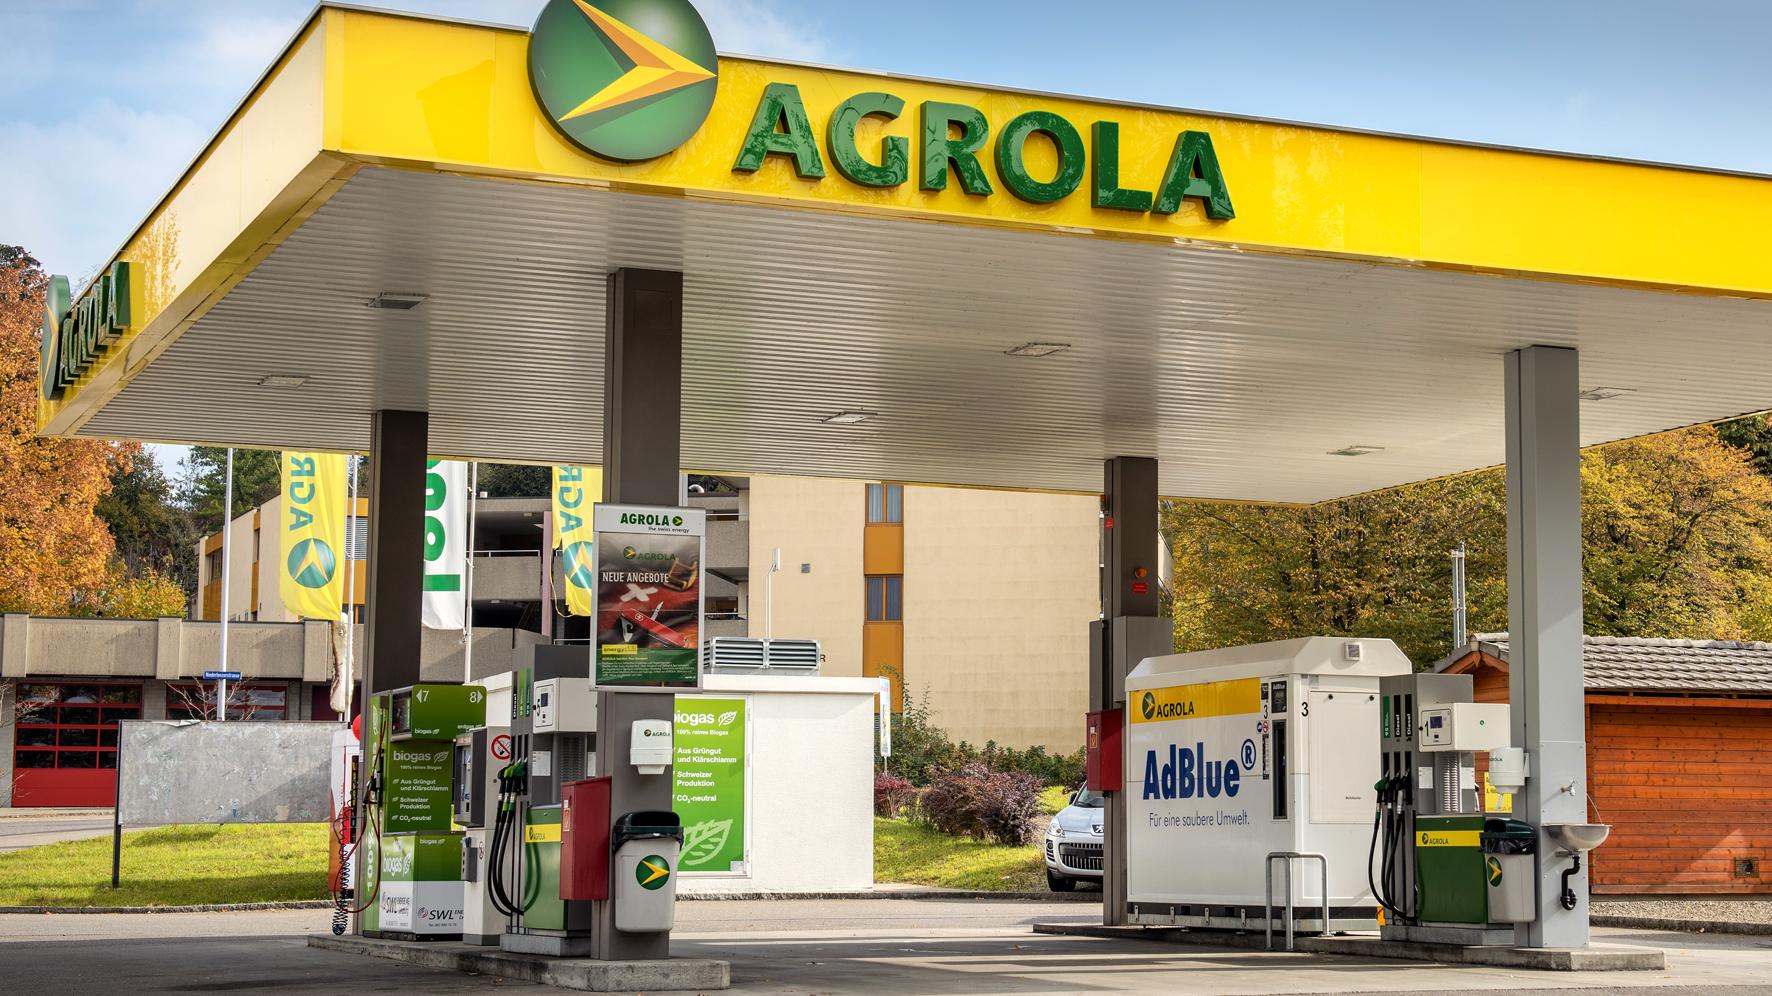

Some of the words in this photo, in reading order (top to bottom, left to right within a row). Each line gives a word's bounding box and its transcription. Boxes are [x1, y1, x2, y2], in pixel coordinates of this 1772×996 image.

[731, 82, 1236, 220] AGROLA
[620, 513, 670, 526] AGROLA
[637, 552, 676, 560] AGROLA
[602, 572, 624, 582] NEUE
[627, 572, 669, 583] ANGEBOTE
[423, 690, 429, 702] 7
[469, 691, 477, 703] 8
[536, 698, 541, 717] 5
[1156, 701, 1195, 718] AGROLA
[1263, 704, 1268, 719] 3
[1301, 701, 1309, 717] 3
[1424, 720, 1429, 737] 1
[393, 750, 431, 763] biogas
[692, 747, 721, 755] Grüngut
[677, 779, 715, 787] Produktion
[1149, 812, 1162, 827] Für
[1163, 811, 1180, 827] eine
[1182, 810, 1214, 826] saubere
[1216, 809, 1250, 826] Umwelt.
[367, 826, 375, 892] 100%
[382, 853, 403, 877] biogas
[428, 909, 455, 920] SWL
